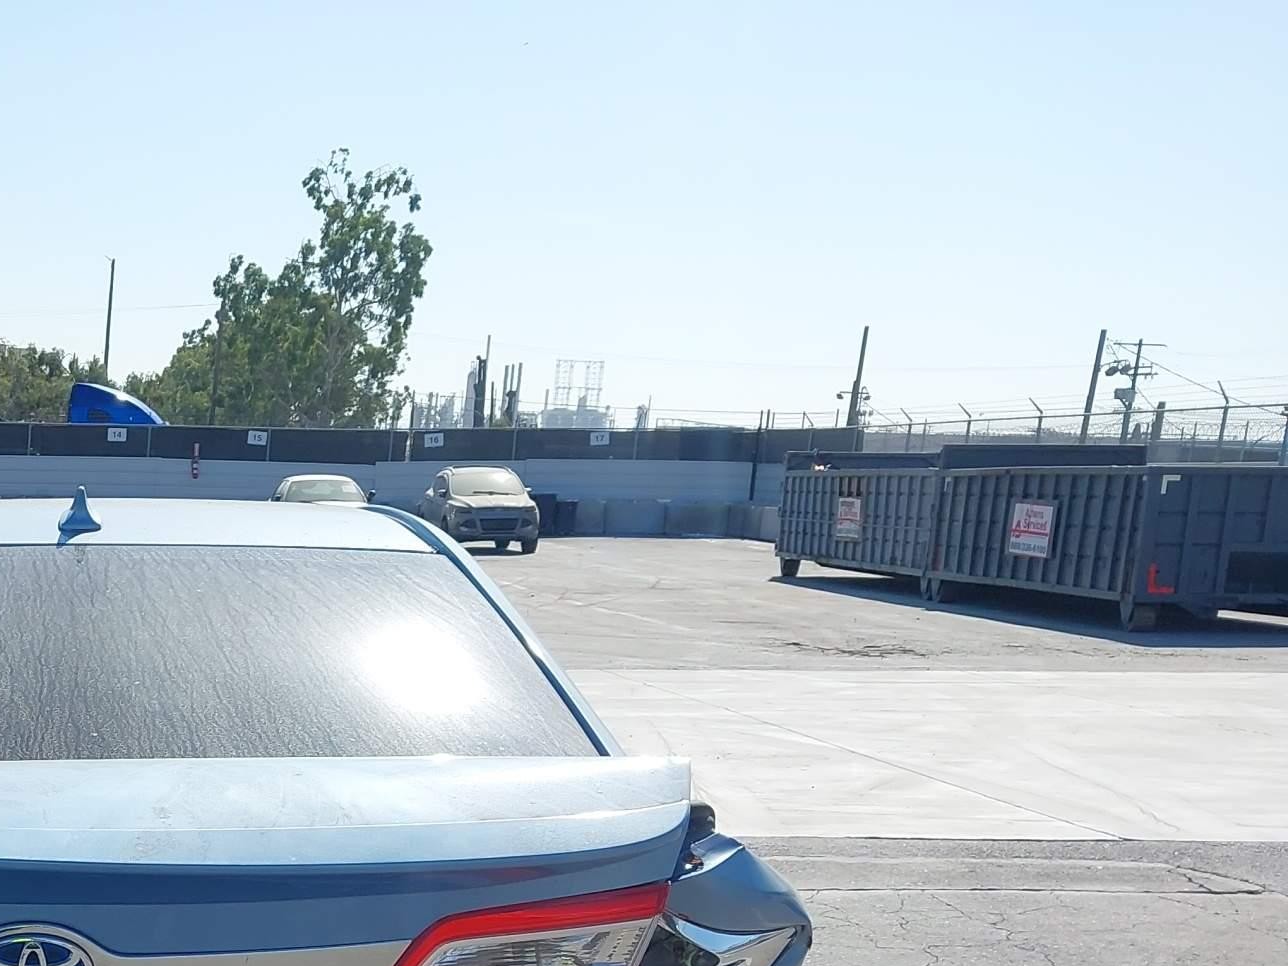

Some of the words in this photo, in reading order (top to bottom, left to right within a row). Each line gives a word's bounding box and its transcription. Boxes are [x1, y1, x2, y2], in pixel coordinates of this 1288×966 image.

[113, 431, 122, 439] 14
[253, 434, 262, 442] 15
[430, 436, 439, 444] 16
